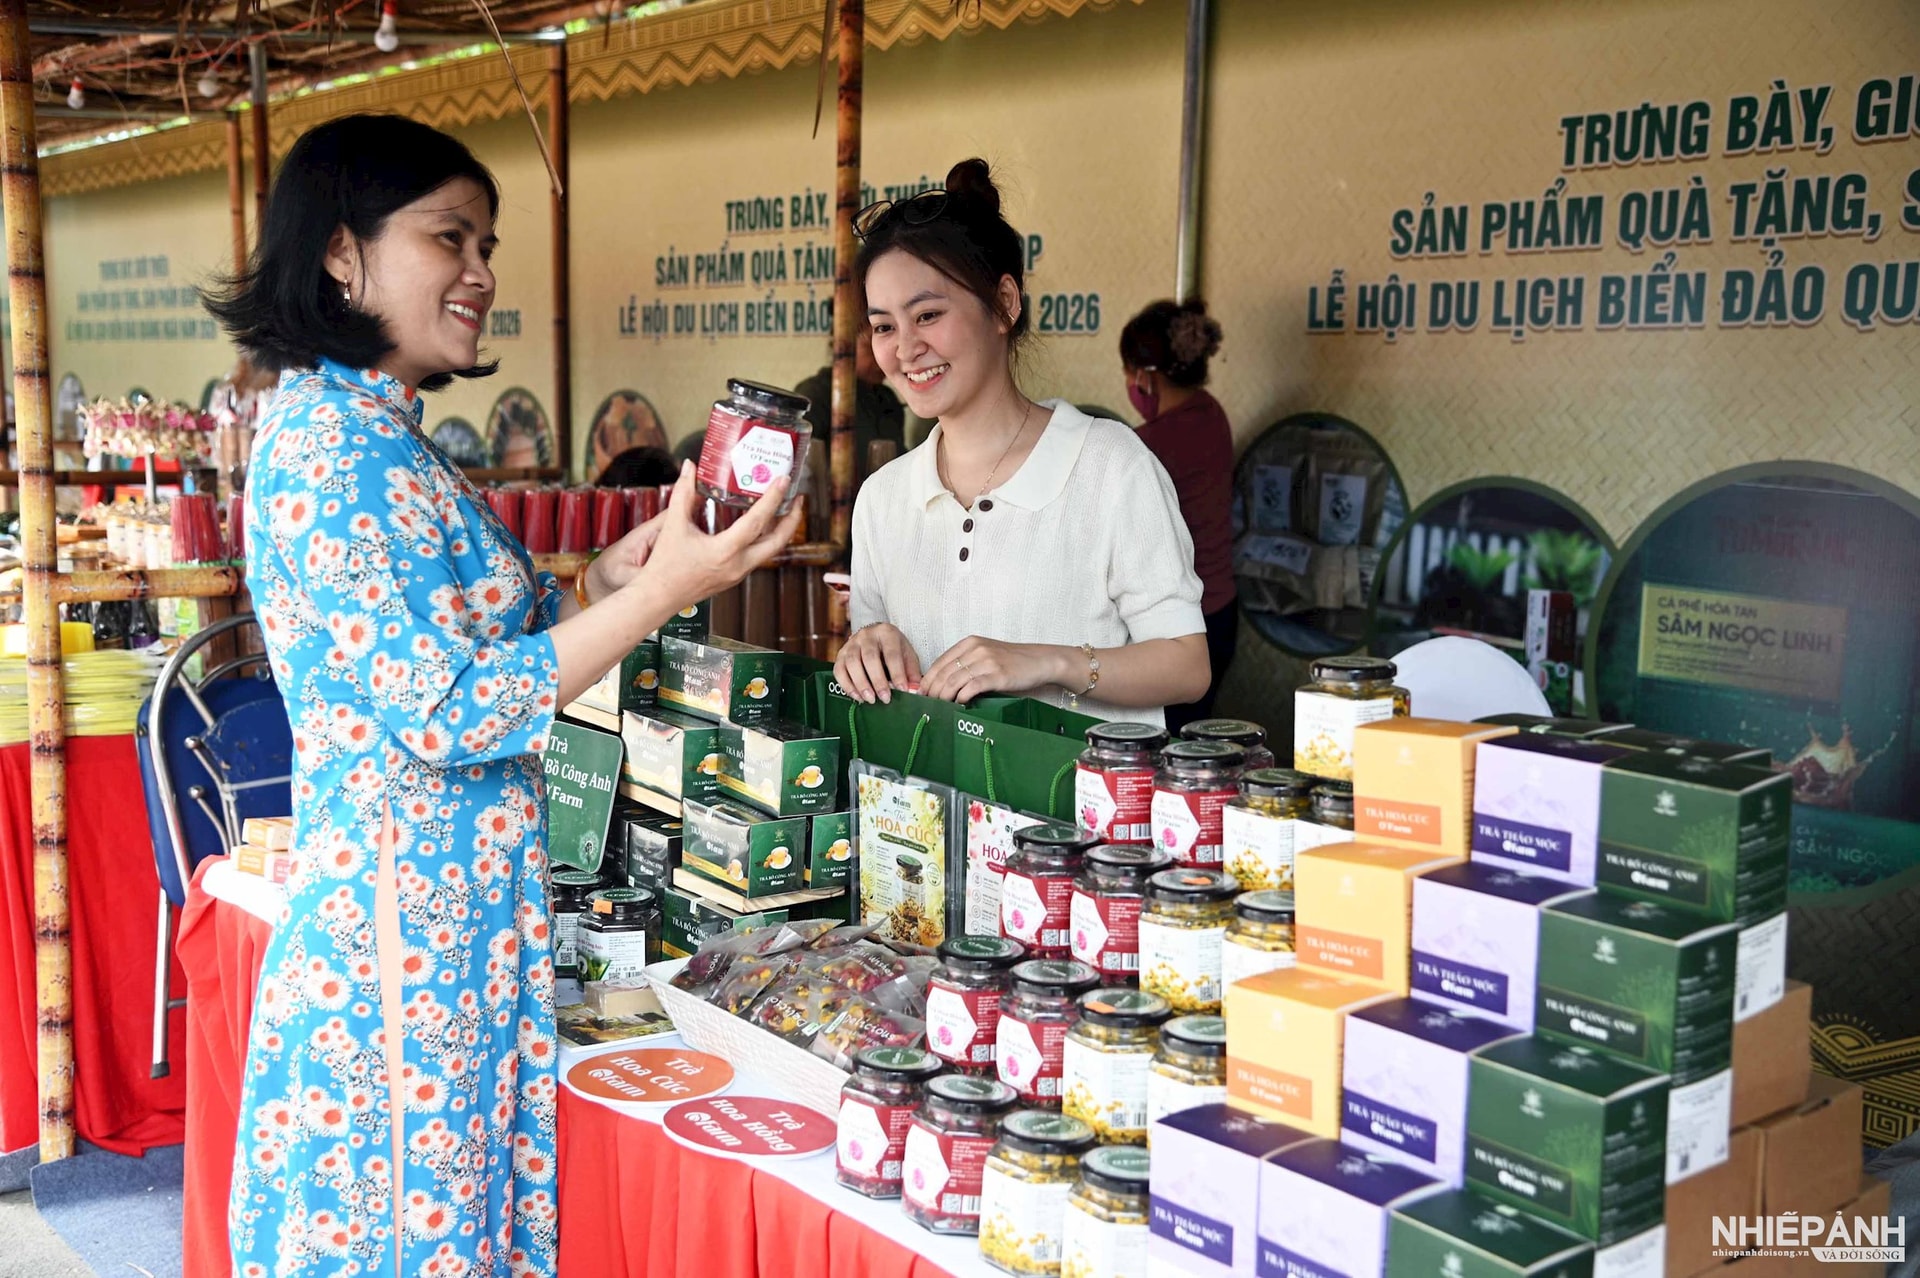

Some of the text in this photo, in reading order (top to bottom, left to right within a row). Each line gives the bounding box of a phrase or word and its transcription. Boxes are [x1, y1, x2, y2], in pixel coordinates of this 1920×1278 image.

[1561, 76, 1920, 167] TRƯNG BÀY, GI
[725, 187, 830, 233] TRƯNG BÀY,
[1391, 168, 1881, 255] SẢN PHẨM QUÀ TẶNG,
[656, 239, 836, 287] SẢN PHẨM QUÀ TẶN
[1308, 250, 1920, 339] LỄ HỘI DU LỊCH BIỂN ĐẢO QU
[641, 298, 669, 343] HỘI
[673, 304, 696, 333] DU
[701, 302, 738, 343] LỊCH
[745, 288, 787, 333] BIỂN
[1039, 292, 1100, 331] 2026
[1657, 612, 1703, 638] SÂM
[1708, 621, 1776, 650] NGỌC
[550, 735, 568, 754] Trà
[958, 719, 984, 736] OCOP
[544, 758, 611, 792] Bồ Công Anh
[876, 816, 902, 835] HOA
[906, 825, 934, 846] CÚC
[982, 843, 1007, 863] HOA
[672, 916, 682, 928] TRÀ
[609, 1056, 691, 1095] Hoa Cúc
[665, 1058, 704, 1076] Trà
[708, 1099, 797, 1151] Hoa Hồng
[768, 1110, 806, 1130] Trà
